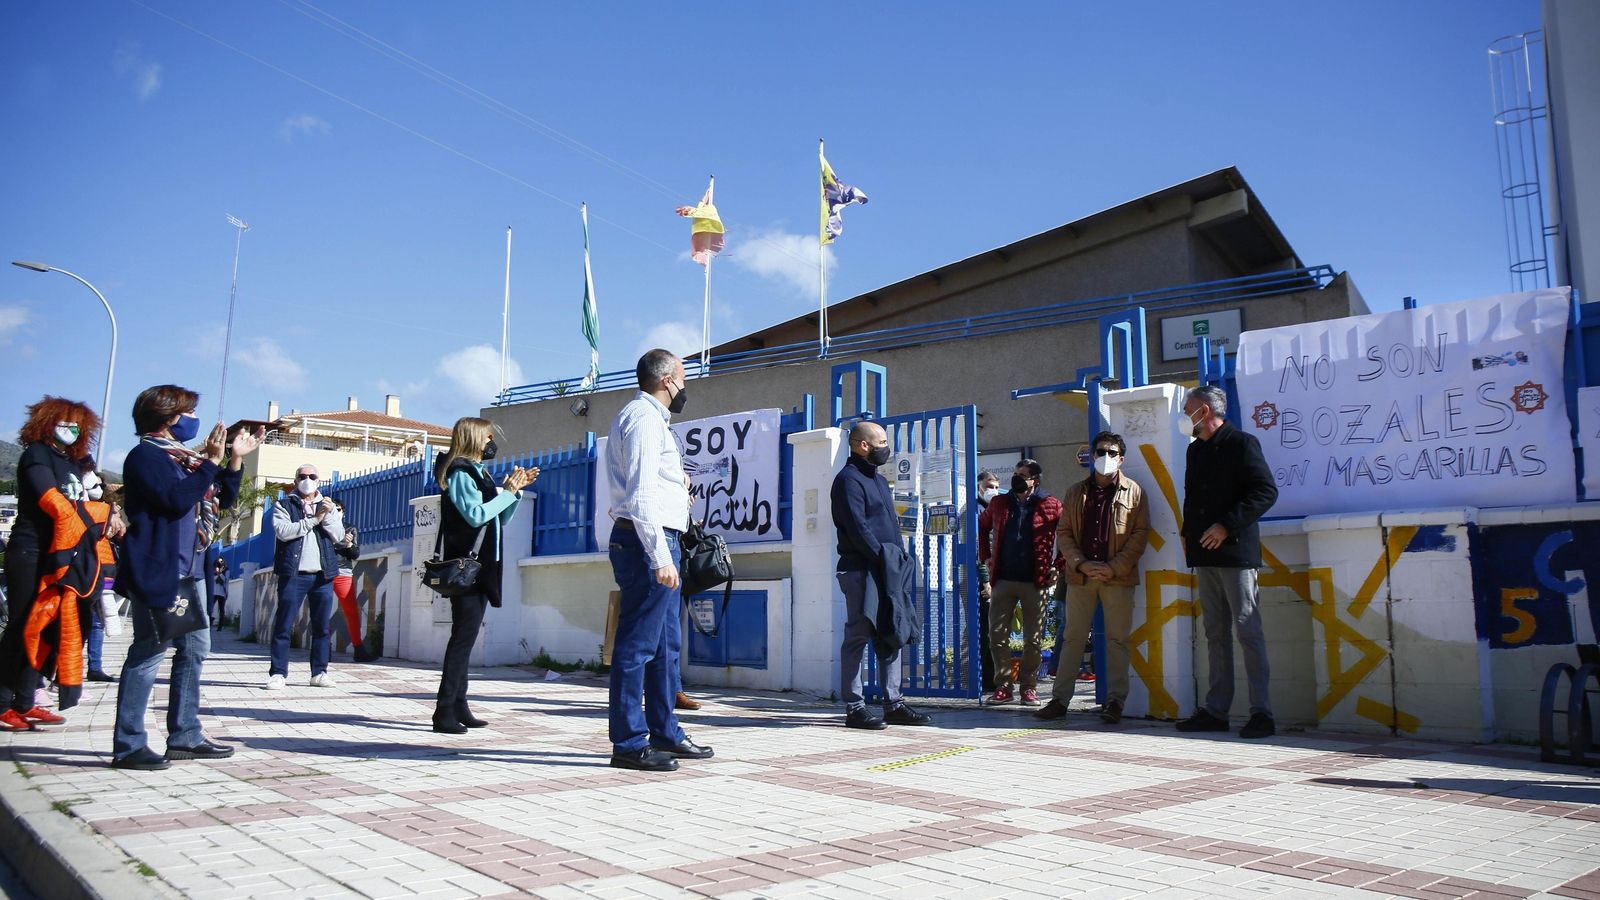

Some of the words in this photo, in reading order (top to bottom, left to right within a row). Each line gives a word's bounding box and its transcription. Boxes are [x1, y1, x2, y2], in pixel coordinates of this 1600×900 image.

[1278, 353, 1336, 393] NO
[1357, 332, 1448, 382] SON
[685, 419, 752, 456] SOY
[1274, 459, 1310, 488] ON
[1500, 587, 1540, 645] 5
